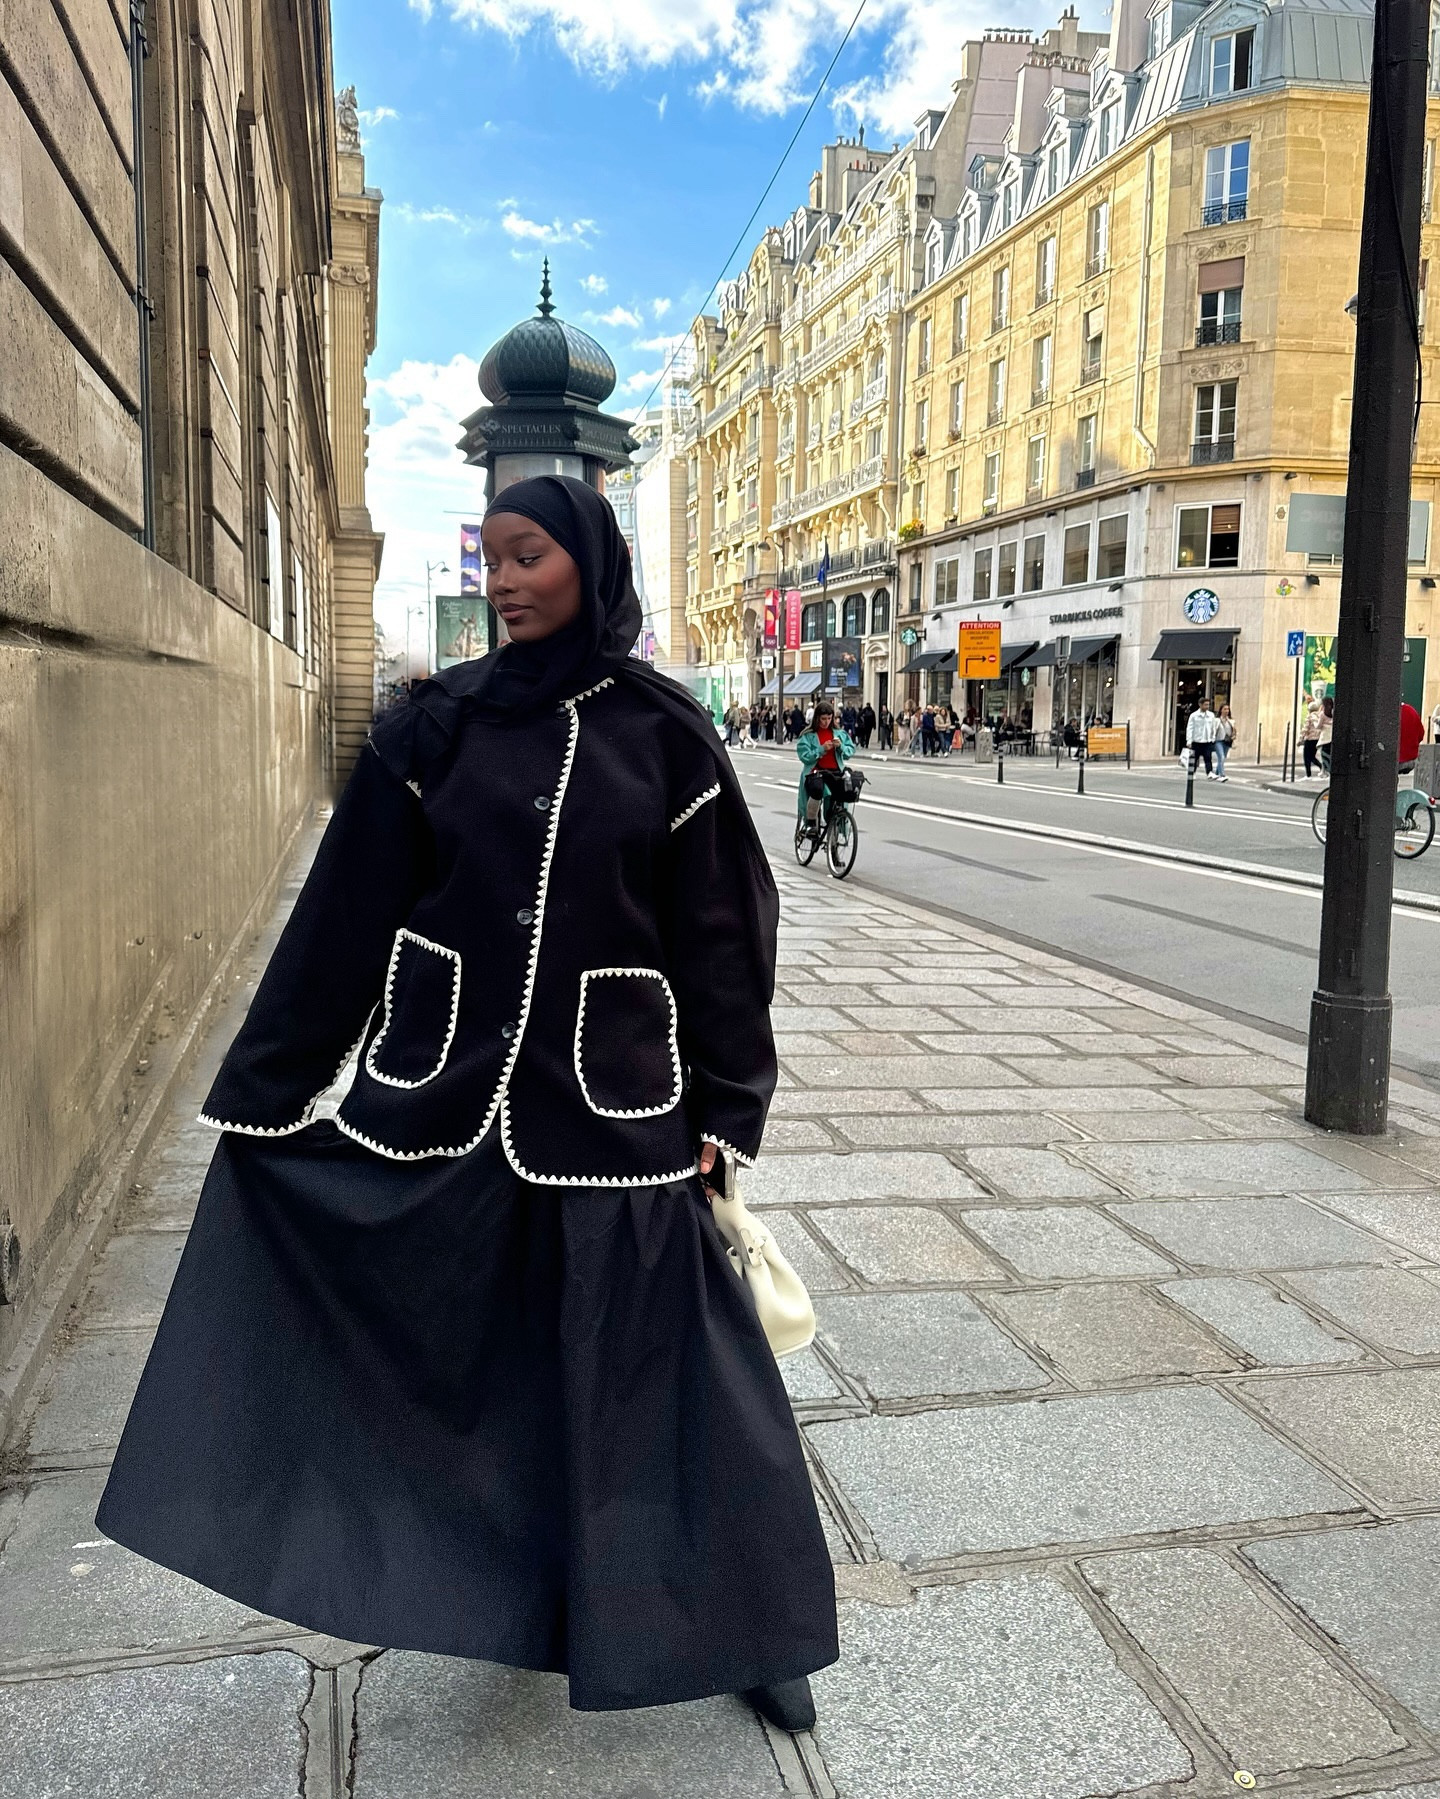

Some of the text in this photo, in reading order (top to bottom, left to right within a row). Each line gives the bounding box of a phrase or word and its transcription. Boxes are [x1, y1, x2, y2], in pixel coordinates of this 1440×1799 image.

[502, 424, 561, 434] SPECTACLES
[1049, 606, 1123, 625] STARBUCKS COFFEE
